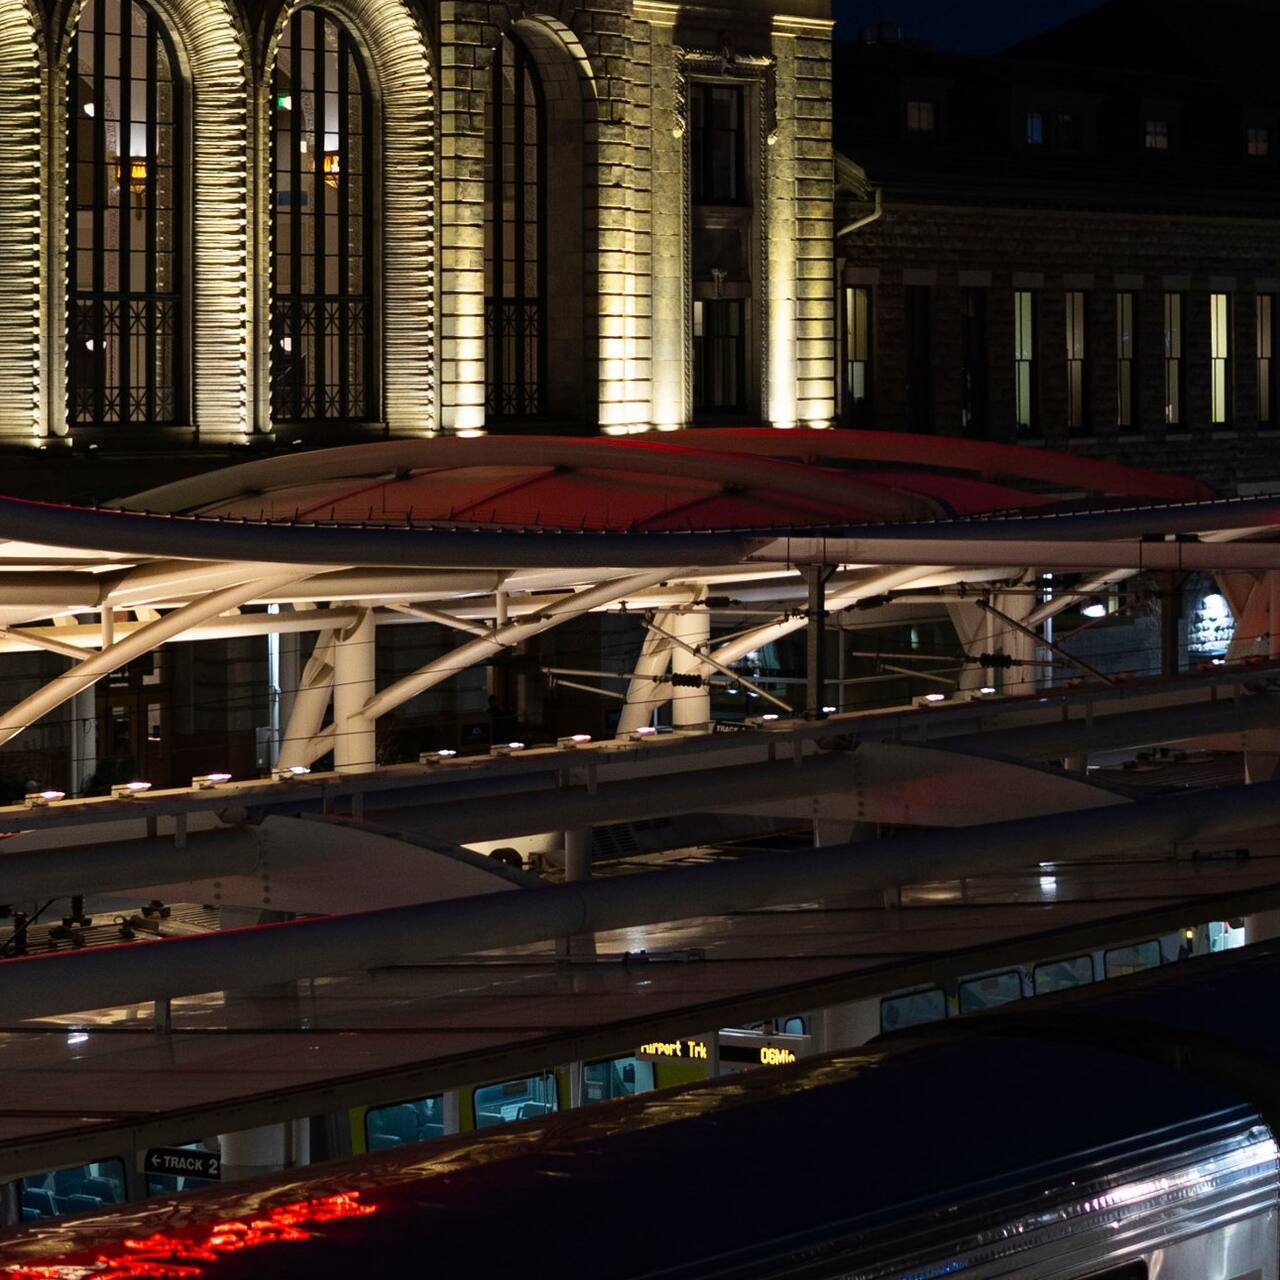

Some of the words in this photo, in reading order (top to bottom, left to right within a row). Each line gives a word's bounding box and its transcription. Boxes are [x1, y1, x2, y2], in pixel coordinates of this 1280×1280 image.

[687, 1040, 707, 1059] Trk
[163, 1154, 204, 1171] TRACK
[207, 1158, 219, 1175] 2
